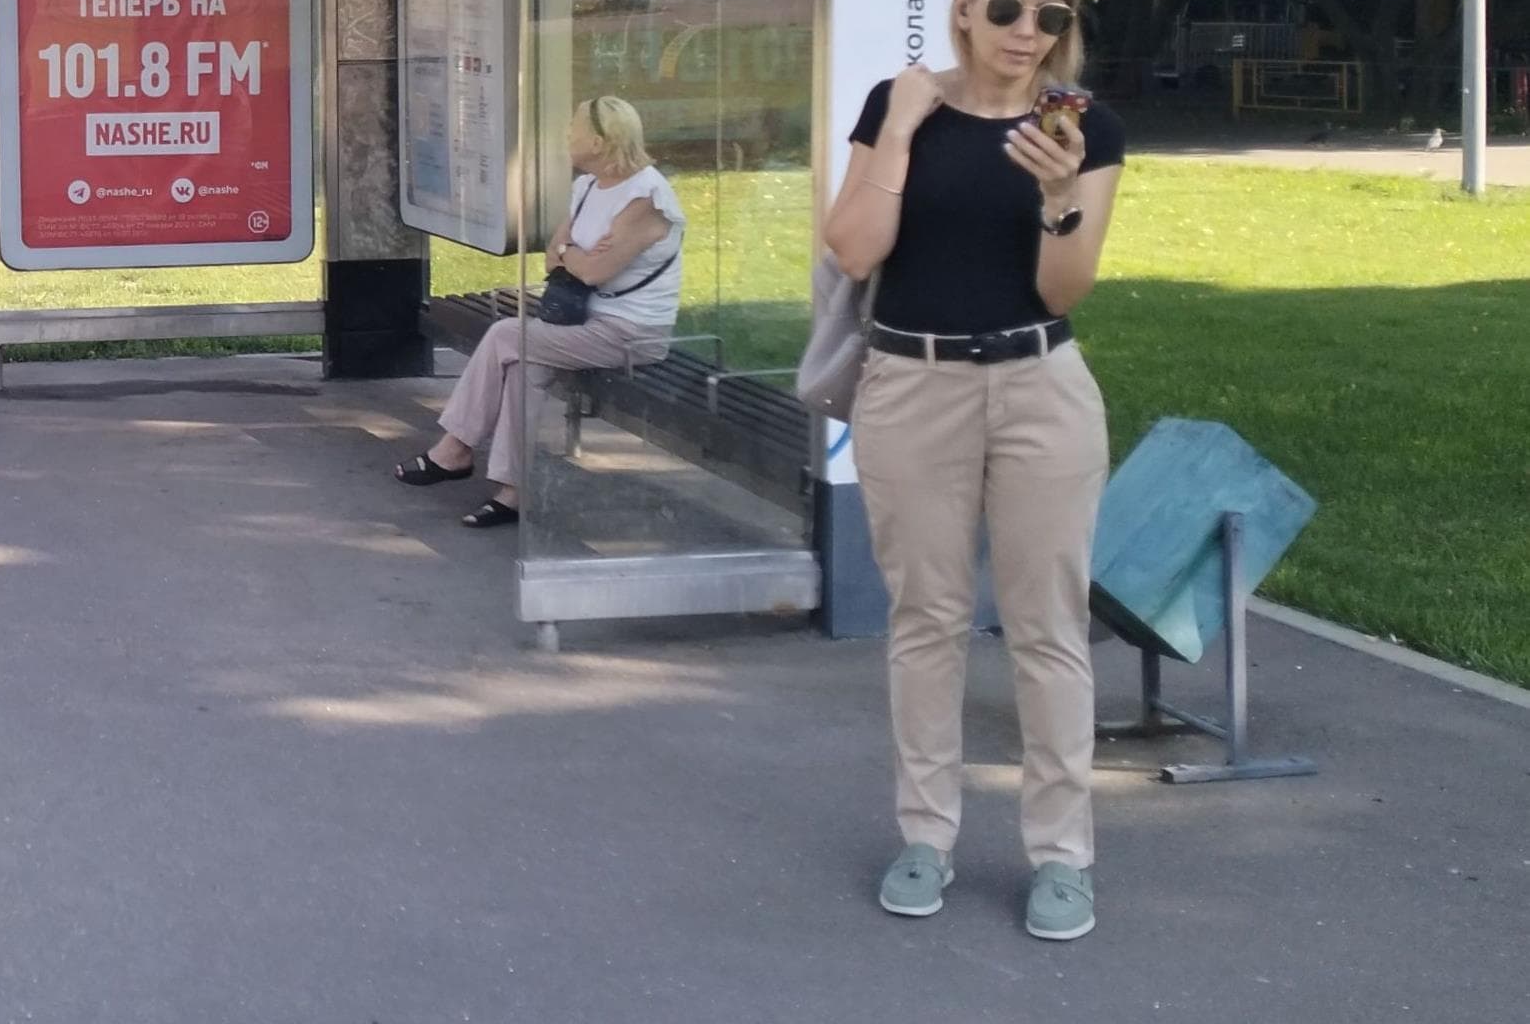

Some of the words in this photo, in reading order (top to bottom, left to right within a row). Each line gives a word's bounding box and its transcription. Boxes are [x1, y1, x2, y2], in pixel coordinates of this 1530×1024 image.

[38, 41, 170, 98] 101.8
[95, 121, 211, 146] NASHE.RU
[95, 187, 153, 199] @nashe_ru
[197, 185, 239, 195] @nashe
